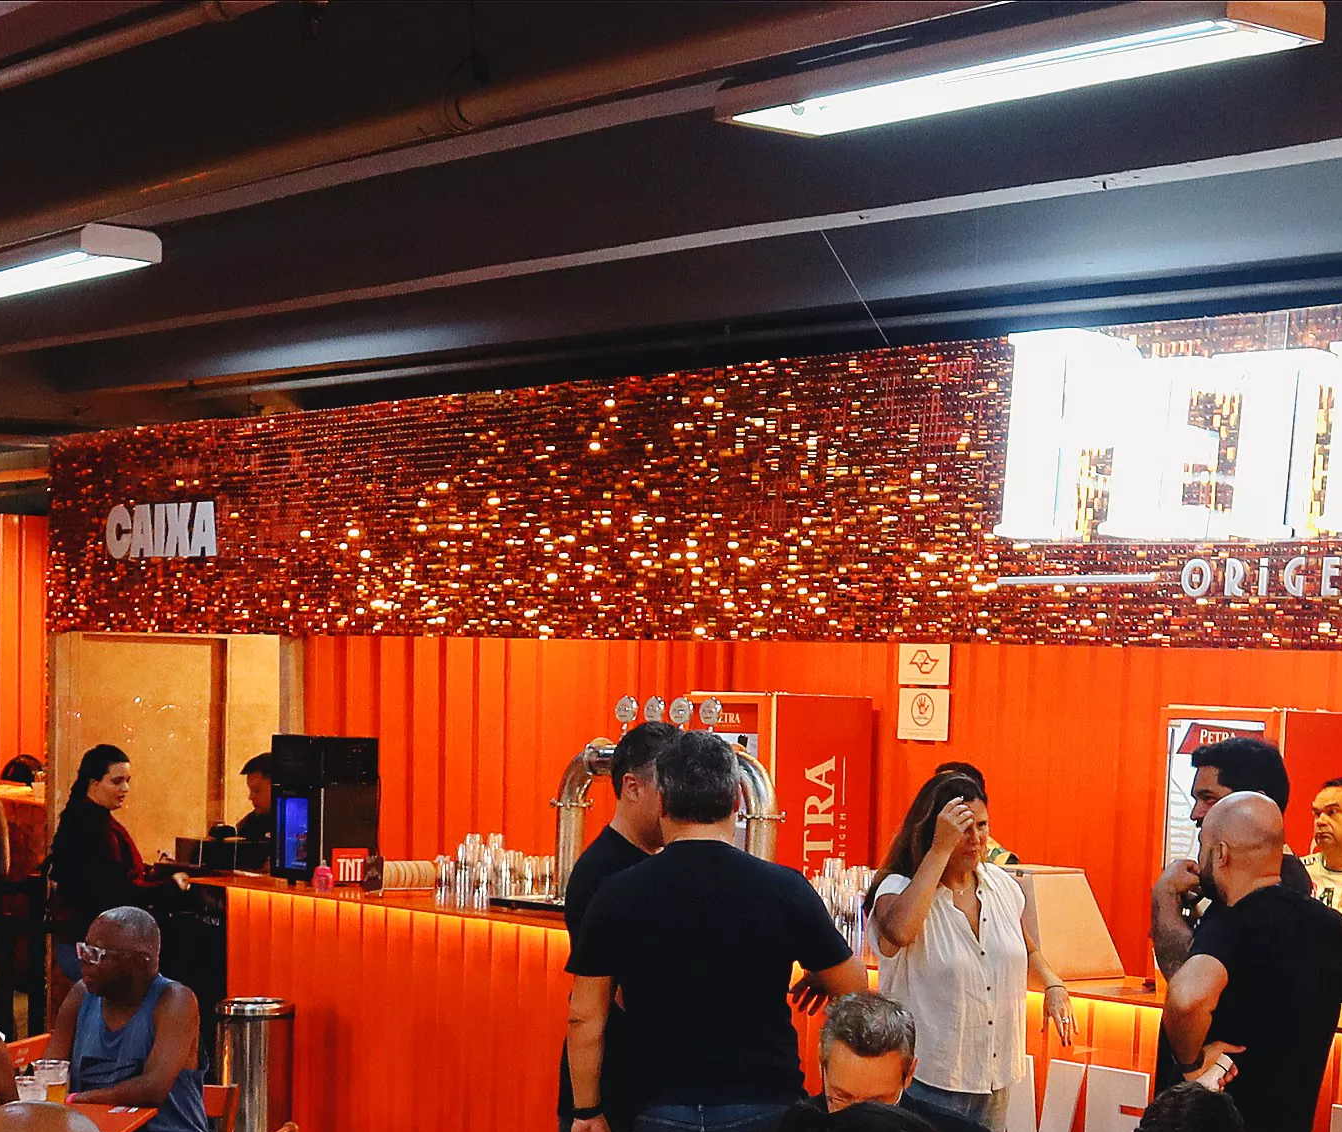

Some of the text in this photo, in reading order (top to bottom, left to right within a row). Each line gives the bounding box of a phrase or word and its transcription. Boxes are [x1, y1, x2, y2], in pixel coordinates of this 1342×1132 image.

[105, 501, 218, 559] CAIXA
[717, 712, 741, 724] ETRA
[336, 858, 365, 882] TNT
